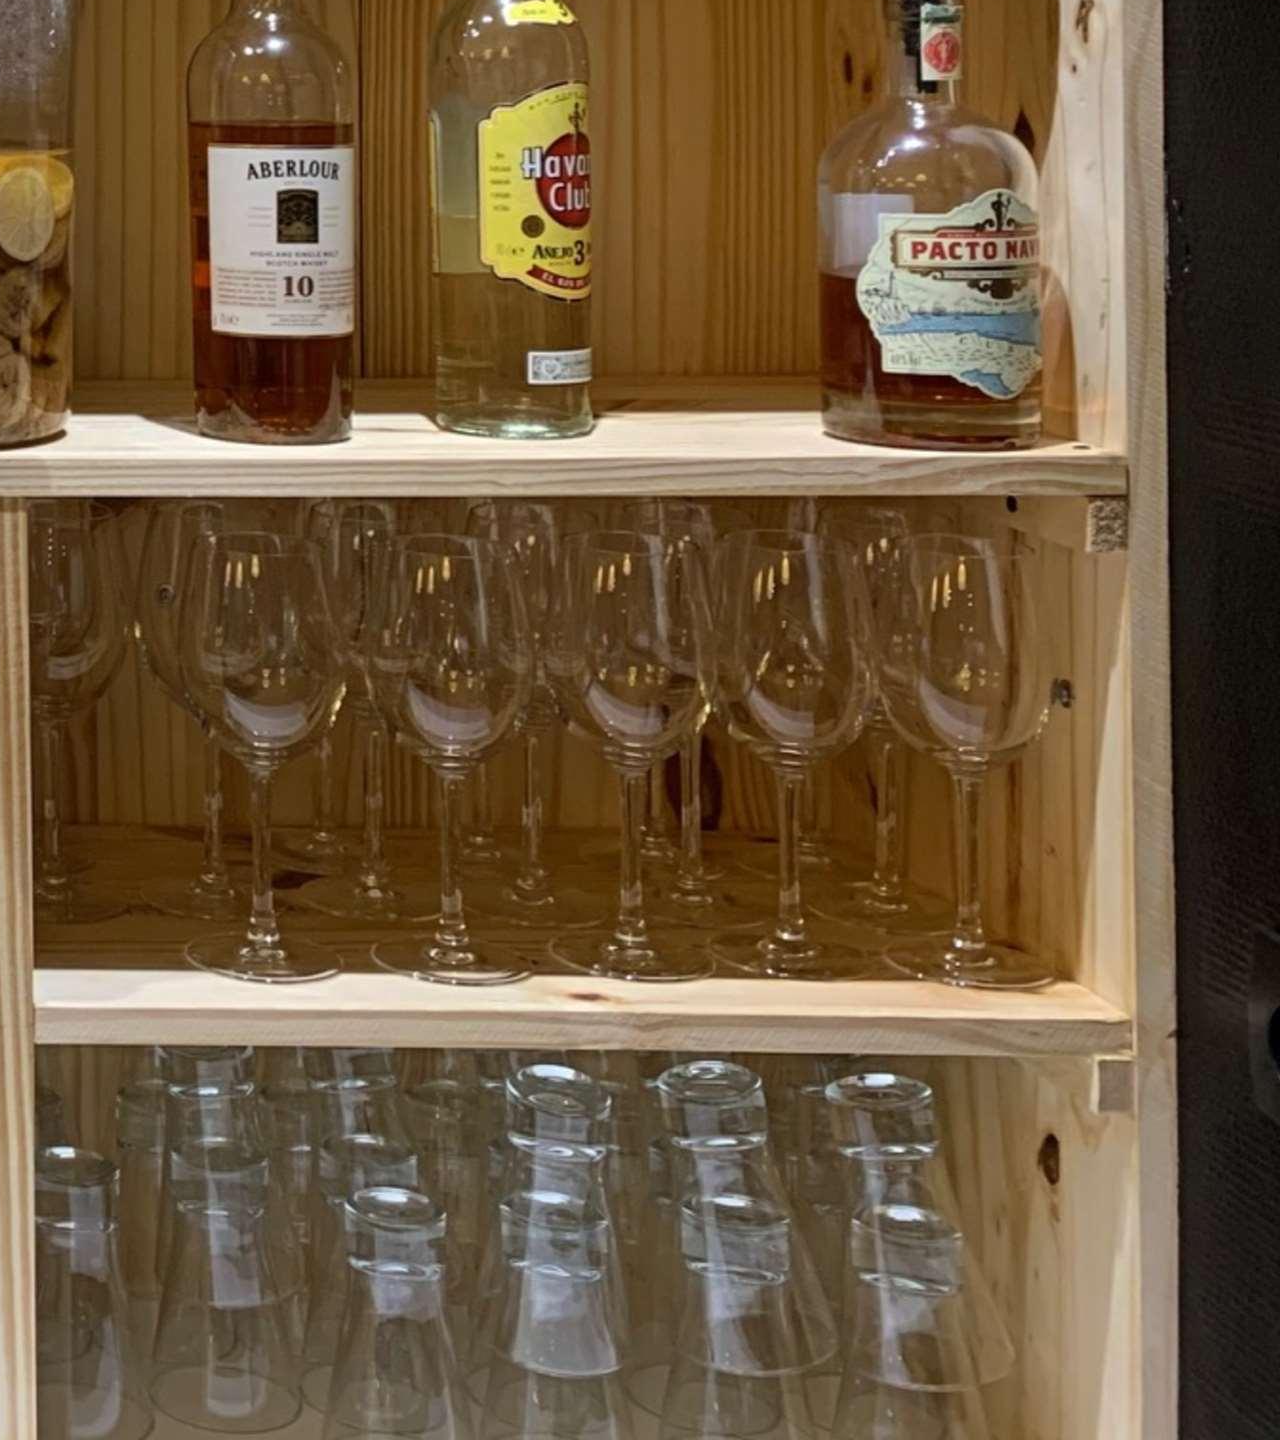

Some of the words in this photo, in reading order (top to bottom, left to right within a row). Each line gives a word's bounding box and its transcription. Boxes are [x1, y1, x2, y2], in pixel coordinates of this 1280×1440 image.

[246, 159, 341, 182] ABERLOUR
[521, 146, 590, 180] Hava
[910, 240, 999, 261] PACTO
[1005, 239, 1041, 260] NAV
[283, 274, 315, 298] 10
